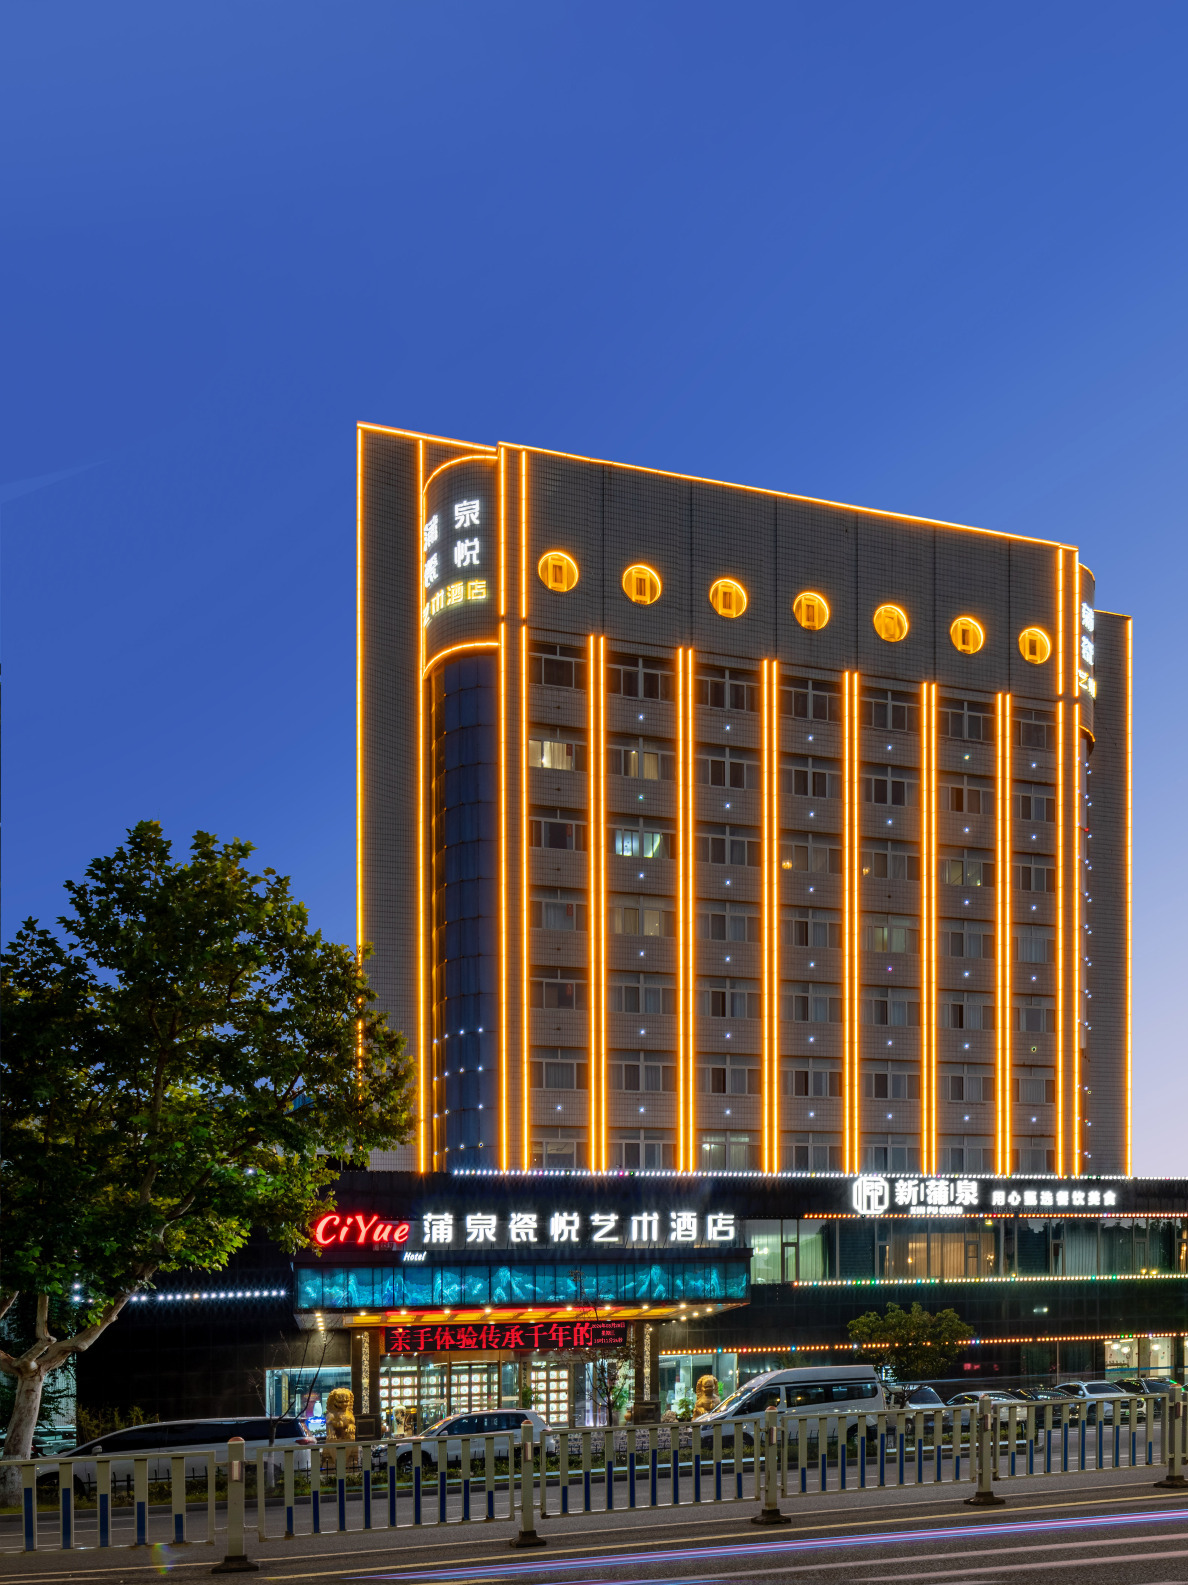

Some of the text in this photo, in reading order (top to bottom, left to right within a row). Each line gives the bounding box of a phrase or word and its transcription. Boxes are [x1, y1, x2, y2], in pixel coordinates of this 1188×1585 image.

[910, 1206, 963, 1214] XIN PU QUAN
[316, 1215, 410, 1245] CiYue
[423, 1212, 735, 1243] 蒲泉瓷悦艺术酒店
[403, 1251, 427, 1261] Hotel
[390, 1322, 593, 1351] 亲手体验传承千年的
